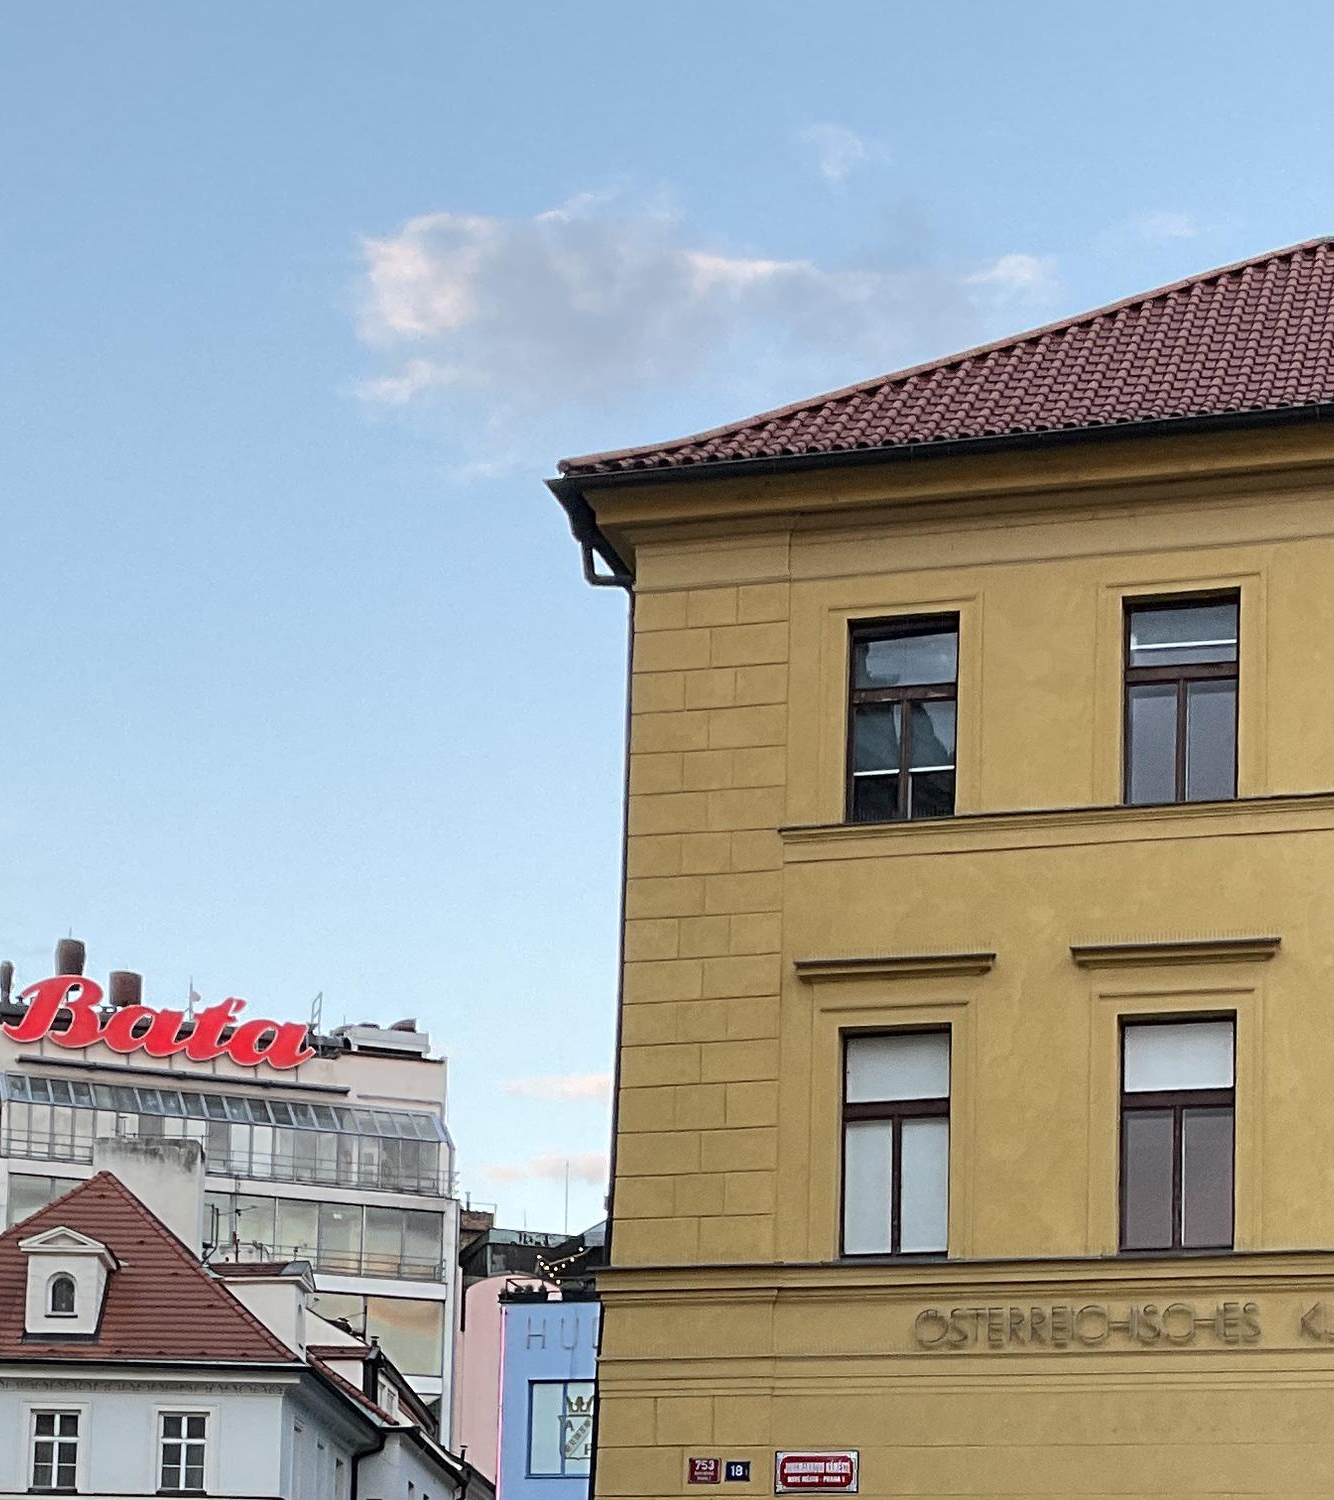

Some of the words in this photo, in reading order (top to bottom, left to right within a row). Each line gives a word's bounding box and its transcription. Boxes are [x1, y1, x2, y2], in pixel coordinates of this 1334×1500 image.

[915, 1303, 1261, 1347] ÖSTERREICHISCHES
[695, 1460, 715, 1471] 753
[730, 1464, 743, 1477] 18
